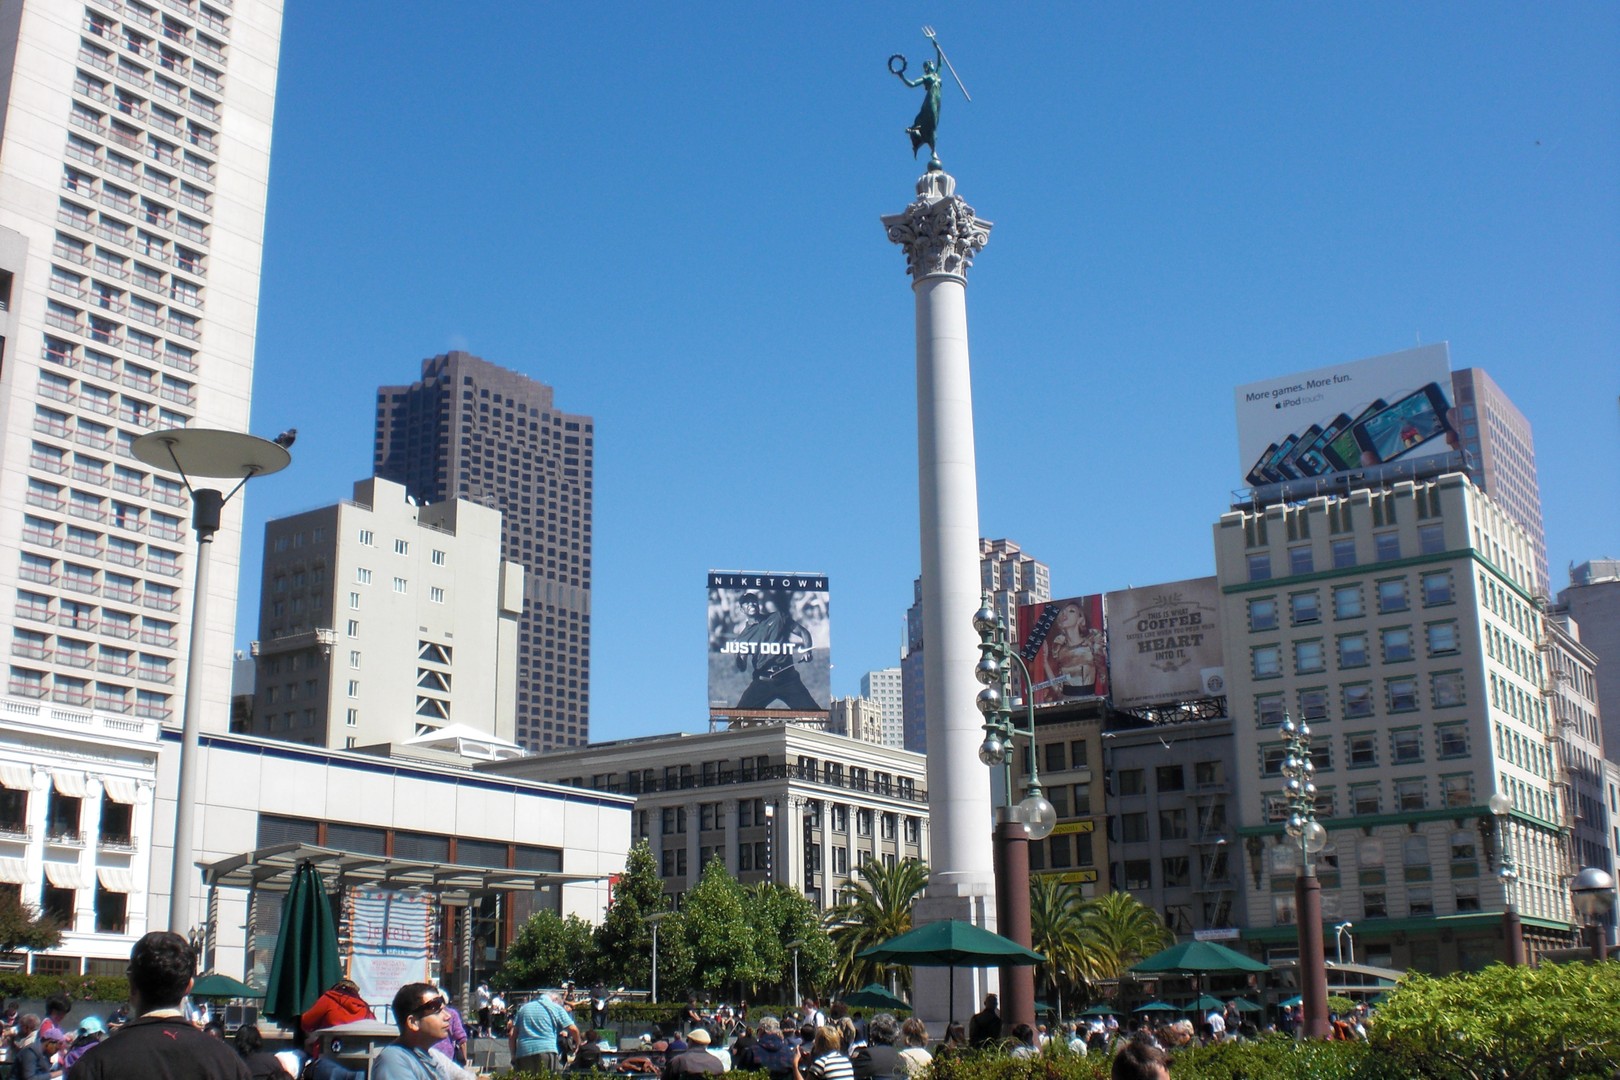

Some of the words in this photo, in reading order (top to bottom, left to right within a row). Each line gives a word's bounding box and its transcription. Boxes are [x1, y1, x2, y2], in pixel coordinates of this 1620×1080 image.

[1246, 391, 1270, 402] More
[1272, 384, 1305, 399] games.
[1306, 379, 1331, 390] More
[1333, 374, 1352, 384] fun.
[1283, 398, 1301, 408] iPod
[1301, 393, 1324, 404] touch
[715, 577, 822, 588] NIKETOWN
[1148, 612, 1161, 620] THIS
[1170, 608, 1188, 617] WHAT
[1137, 612, 1202, 632] COFFEE
[1020, 604, 1052, 657] BARNEYS
[720, 641, 758, 654] JUST
[760, 642, 781, 655] DO
[783, 643, 795, 655] IT
[1137, 633, 1204, 654] HEART
[1155, 650, 1174, 660] INTO
